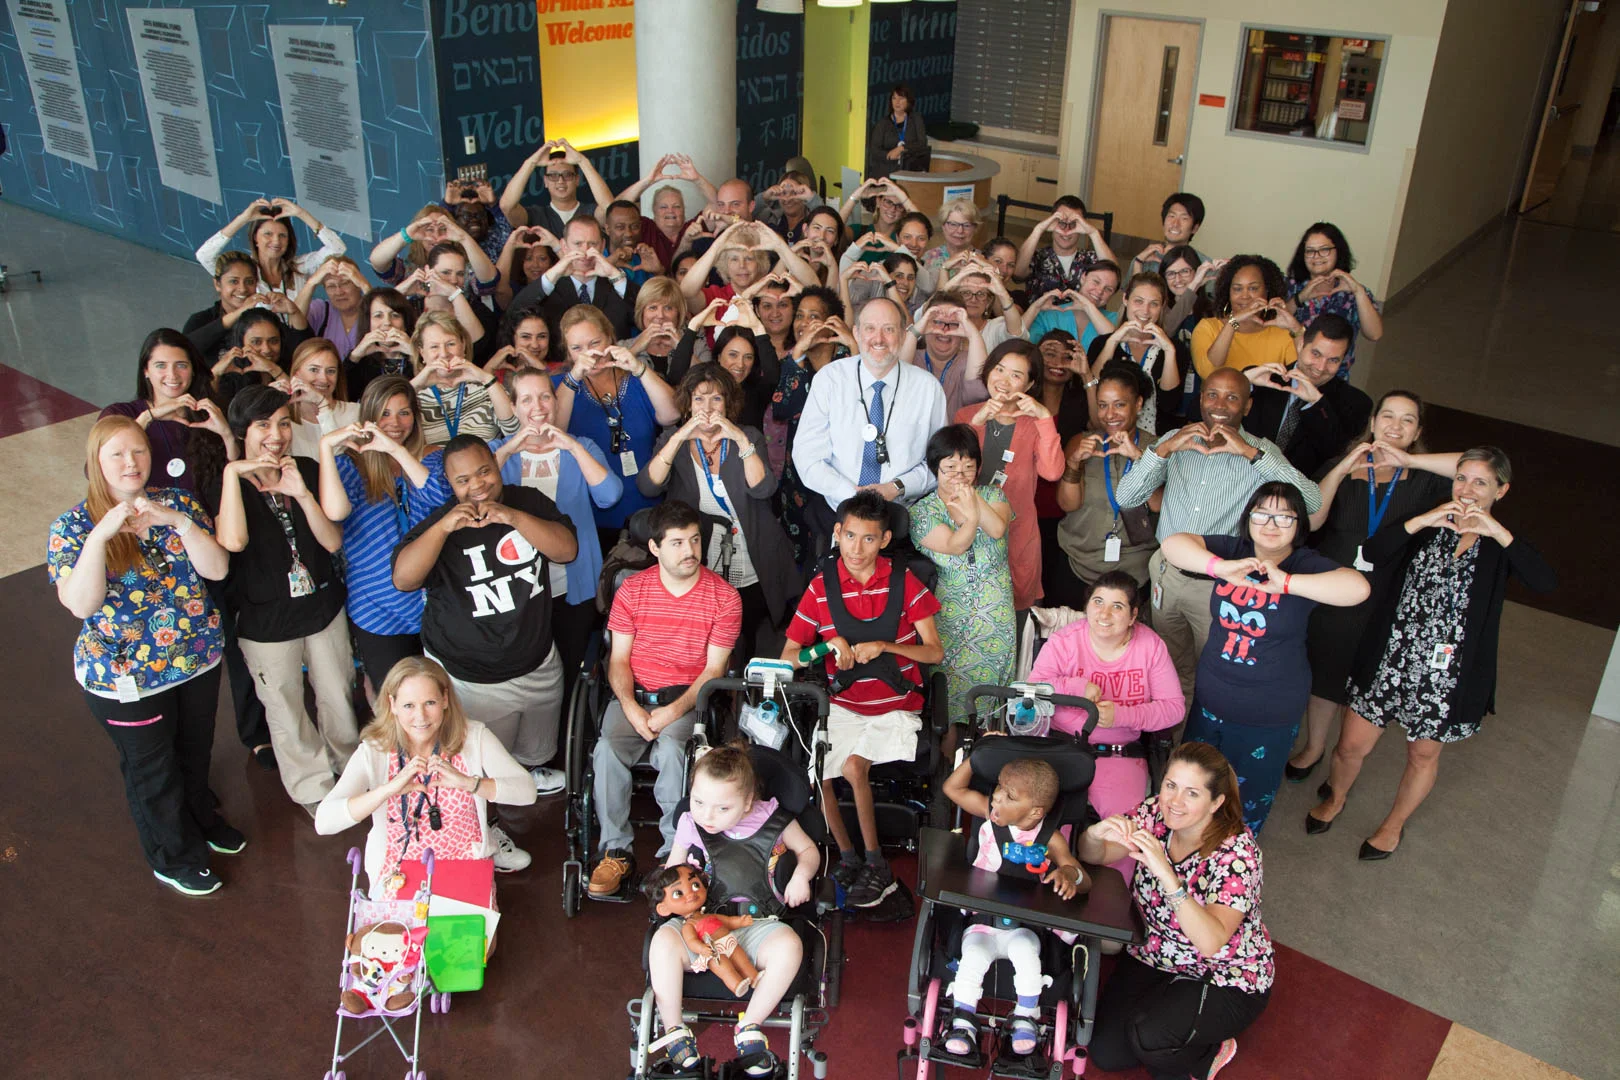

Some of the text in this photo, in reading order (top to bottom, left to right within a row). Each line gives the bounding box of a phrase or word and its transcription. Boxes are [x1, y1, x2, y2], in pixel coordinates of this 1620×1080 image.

[545, 20, 633, 46] Welcome
[463, 544, 494, 582] I
[465, 556, 544, 617] NY
[1219, 600, 1266, 637] DO
[1077, 668, 1144, 698] OVE
